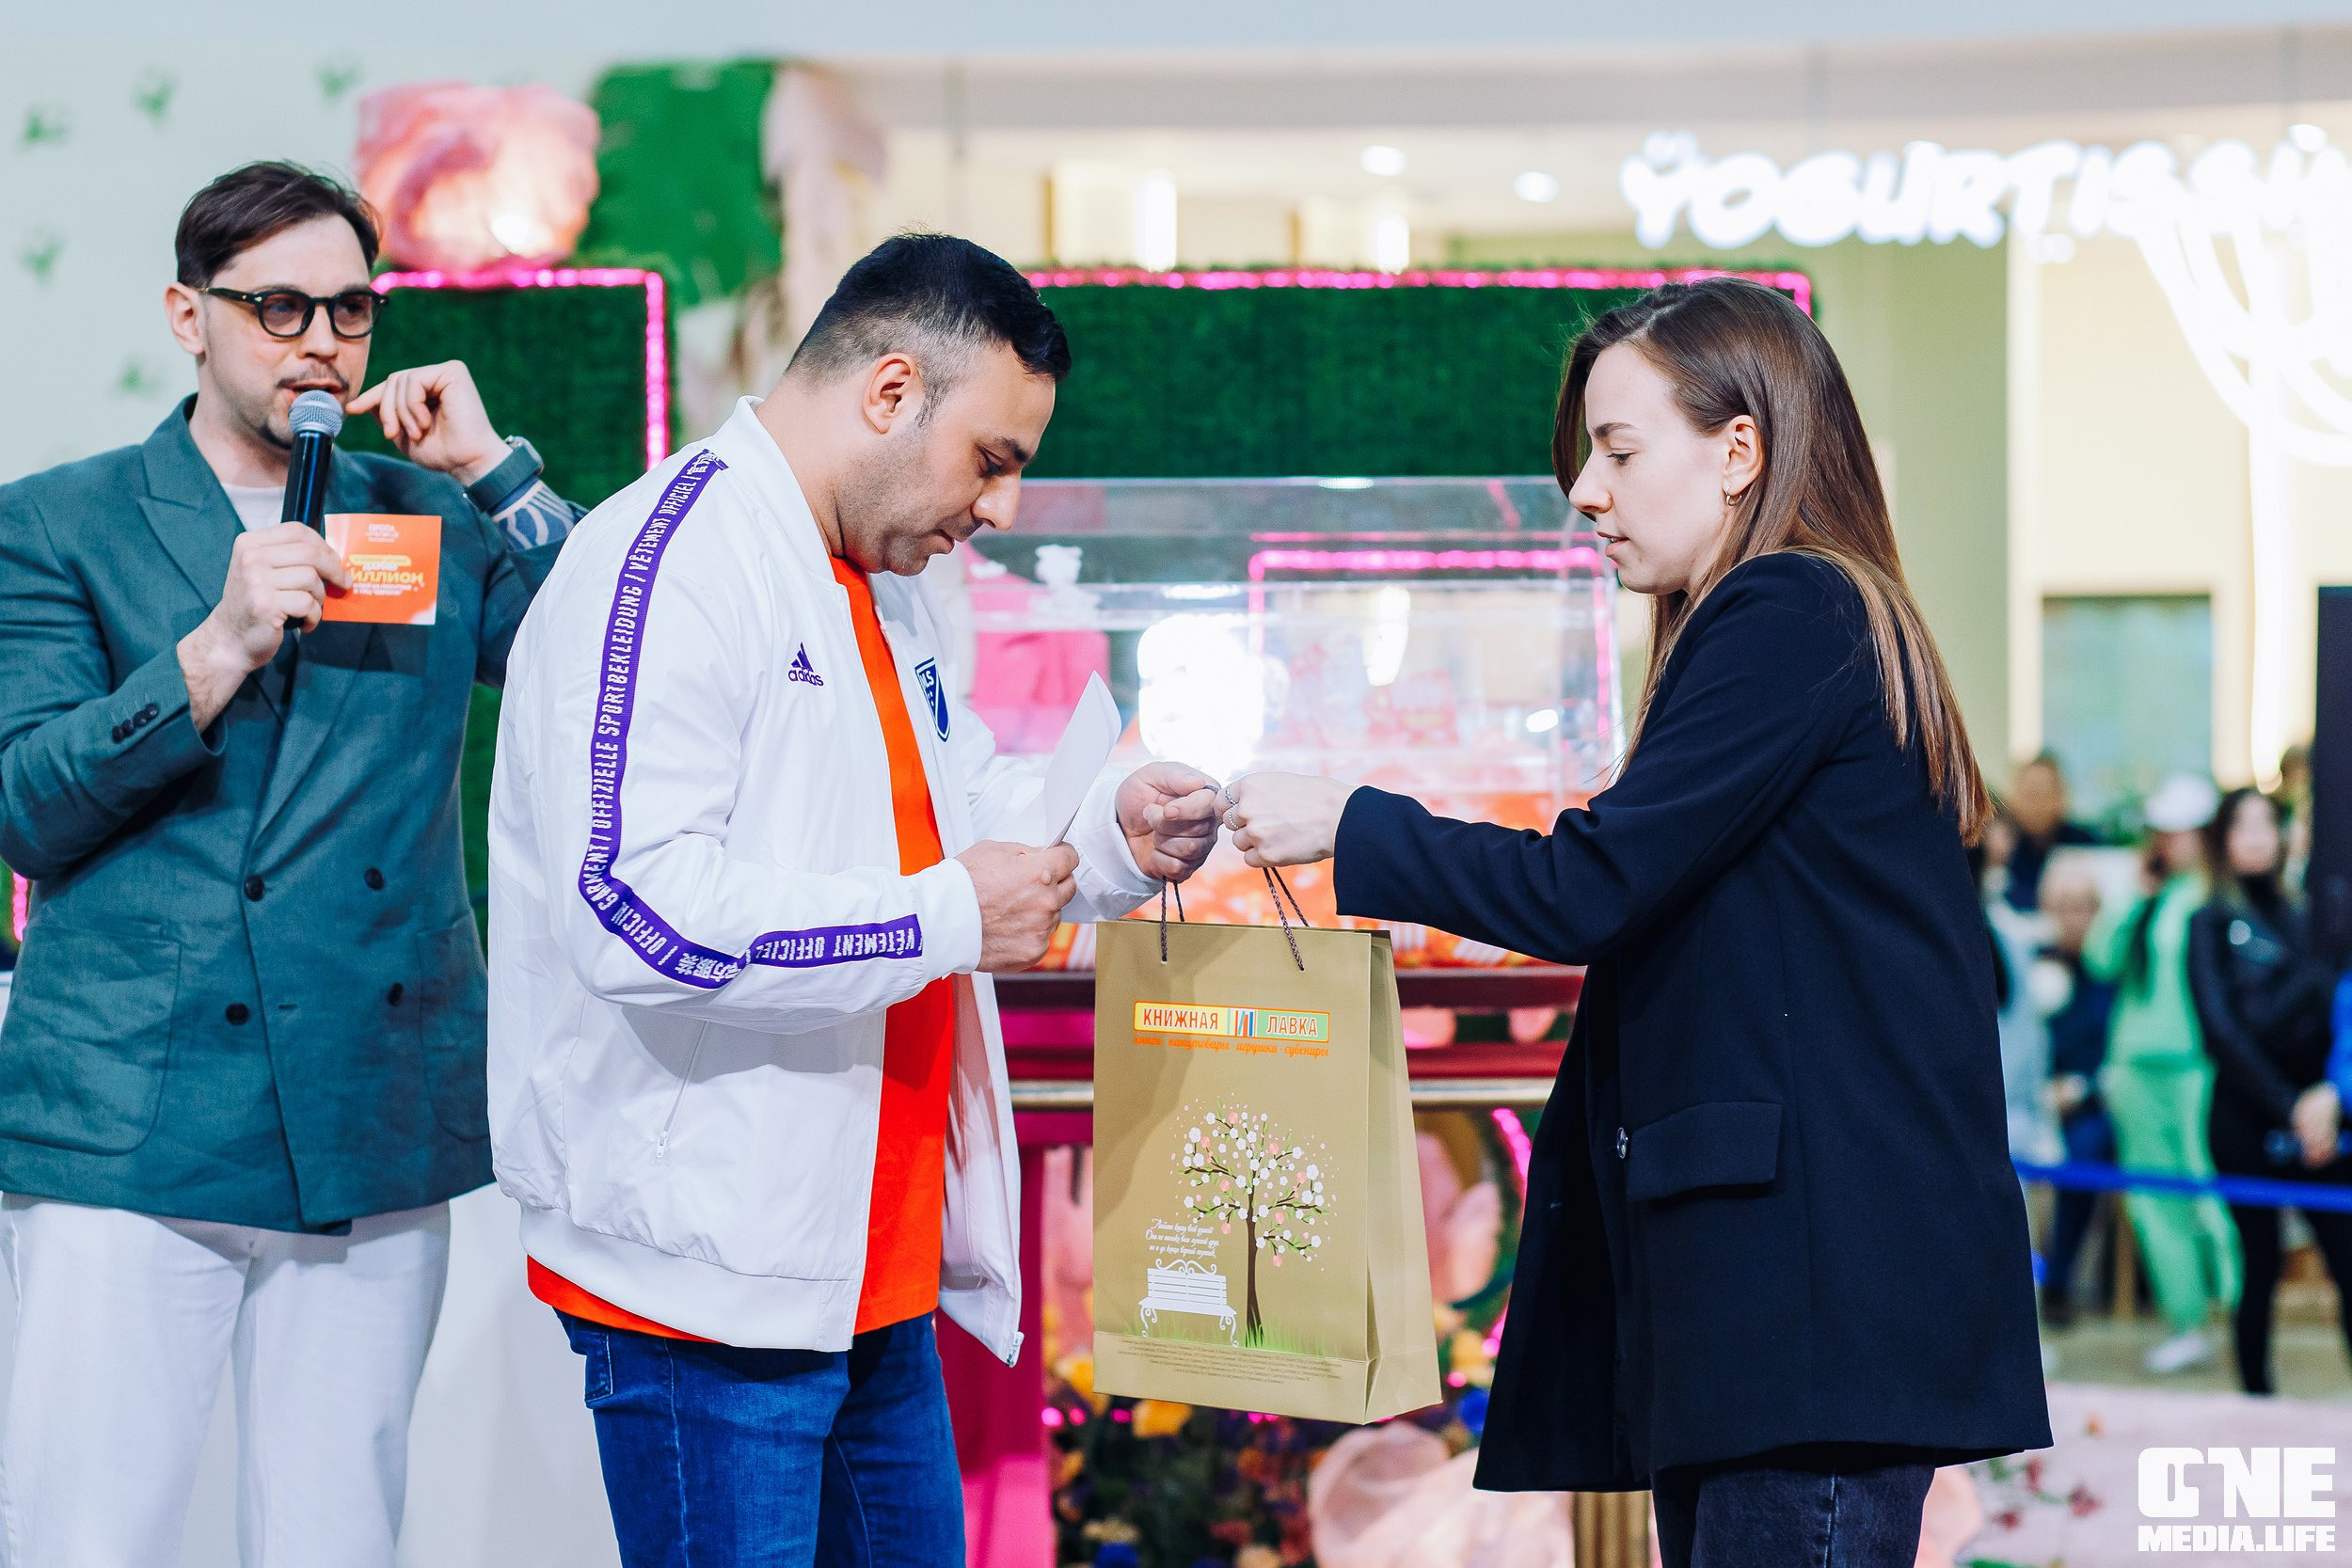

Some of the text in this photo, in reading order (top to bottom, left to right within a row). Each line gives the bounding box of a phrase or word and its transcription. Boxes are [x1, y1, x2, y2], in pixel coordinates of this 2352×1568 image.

[658, 482, 697, 515] OFFICIEL
[350, 570, 423, 584] ИЛЛИОН
[597, 585, 643, 736] SPORTBEKLEIDUNG
[787, 668, 824, 687] adidas
[592, 741, 618, 829] OFFIZIELLE
[582, 843, 619, 911] GARMENT
[755, 936, 825, 960] OFFICIEL
[1142, 1007, 1318, 1037] КНИЖНАЯ ЛАВКА
[1235, 1042, 1278, 1054] игрушки
[1284, 1044, 1329, 1059] сувениры
